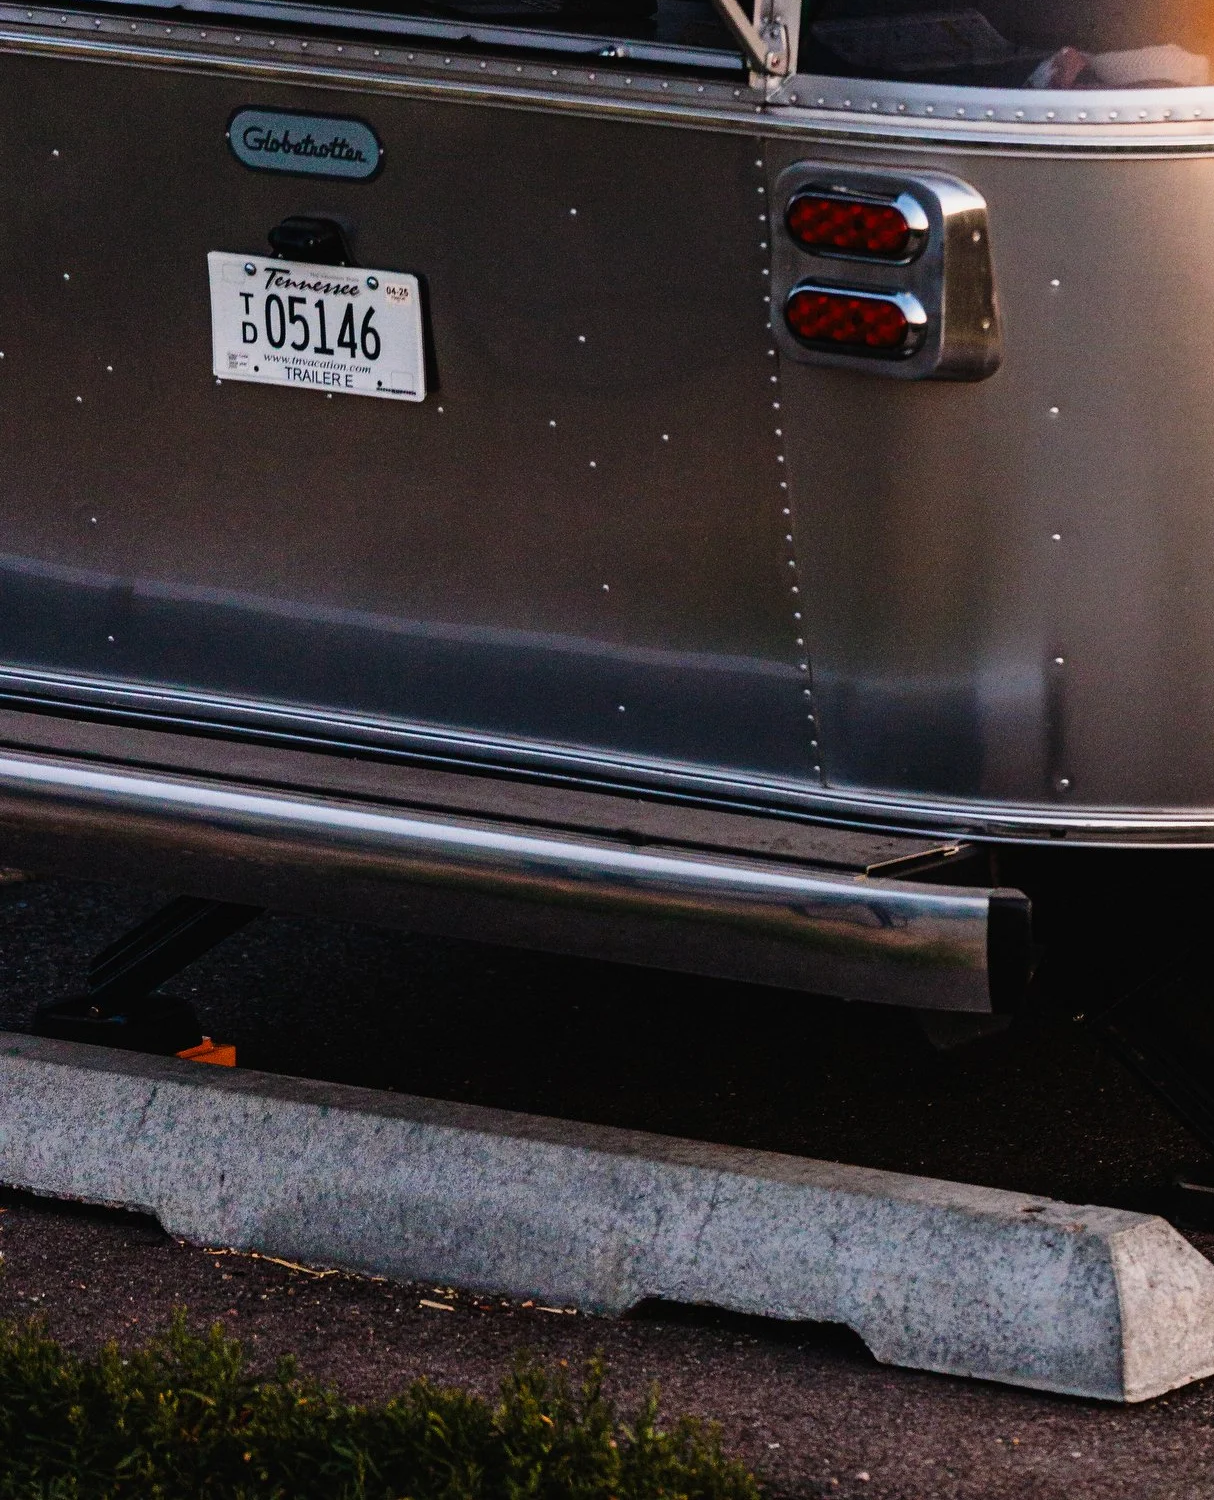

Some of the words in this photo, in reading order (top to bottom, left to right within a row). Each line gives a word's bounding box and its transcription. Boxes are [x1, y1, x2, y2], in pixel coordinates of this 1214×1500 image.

[242, 125, 367, 163] Globetrotter
[263, 267, 360, 297] Tennessee
[265, 293, 381, 361] 05146
[263, 353, 371, 374] www.tnvacation.com
[285, 366, 341, 387] TRAILER
[345, 374, 354, 388] E
